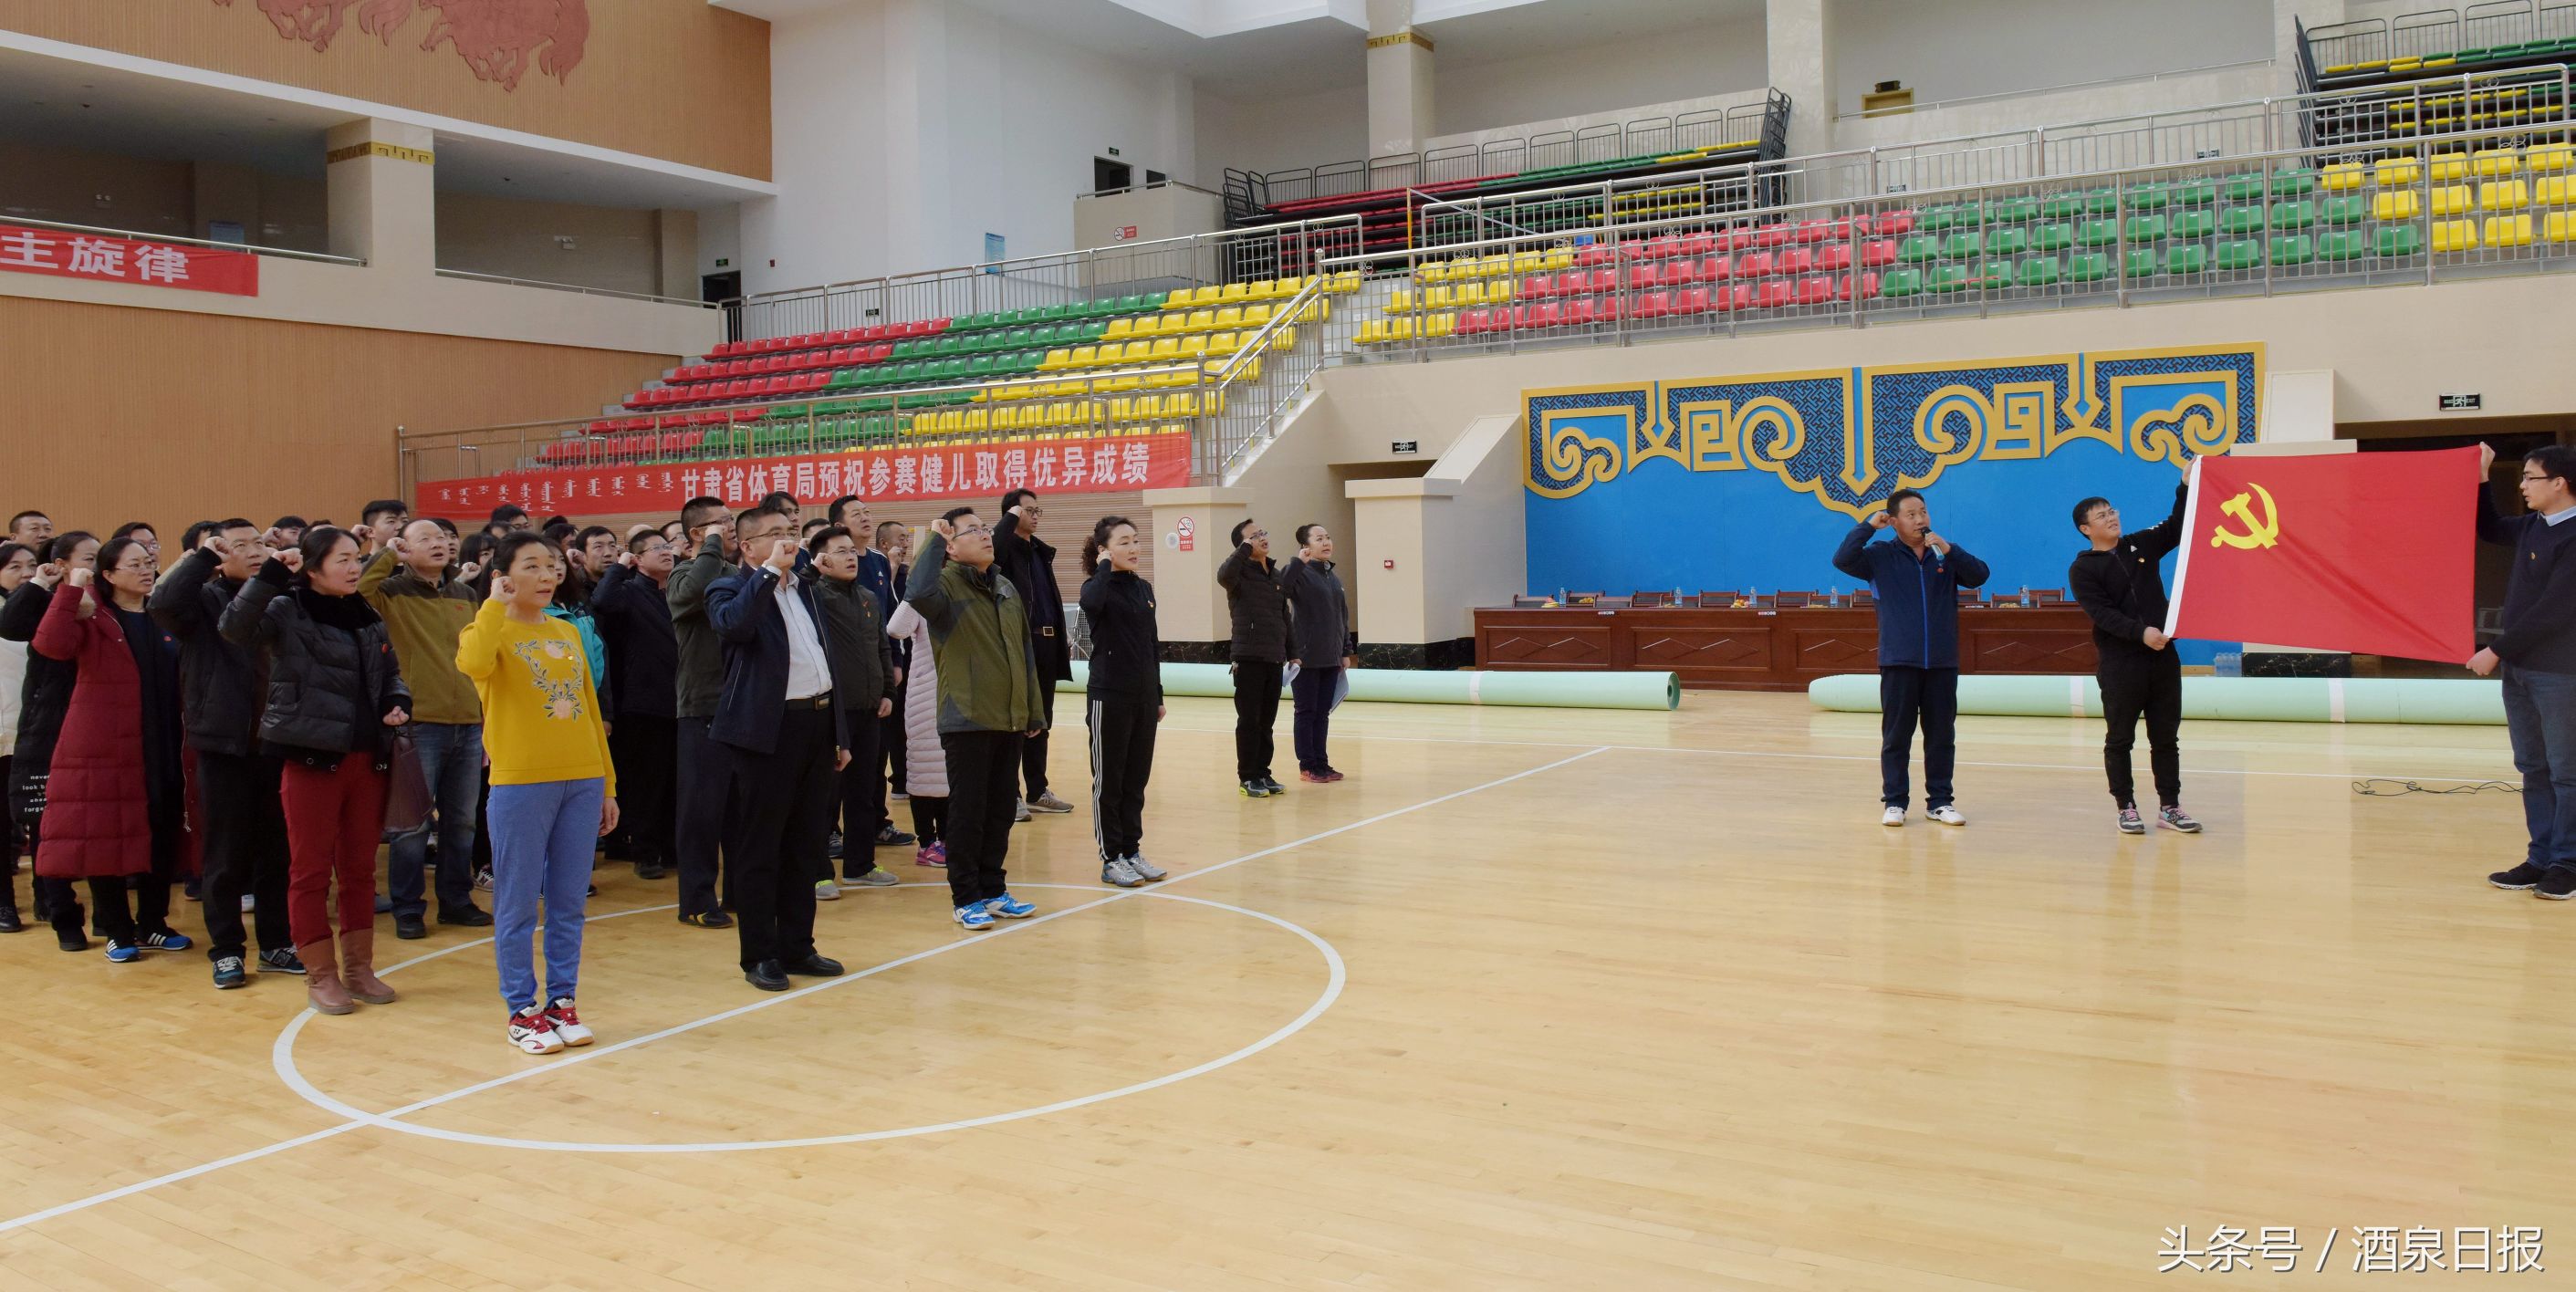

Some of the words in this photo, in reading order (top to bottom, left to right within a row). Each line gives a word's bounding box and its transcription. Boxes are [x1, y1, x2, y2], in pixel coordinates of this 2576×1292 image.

[0, 232, 189, 283] 主旋律
[681, 440, 1149, 503] 甘肃省体育局预祝参赛健儿取得优异成绩
